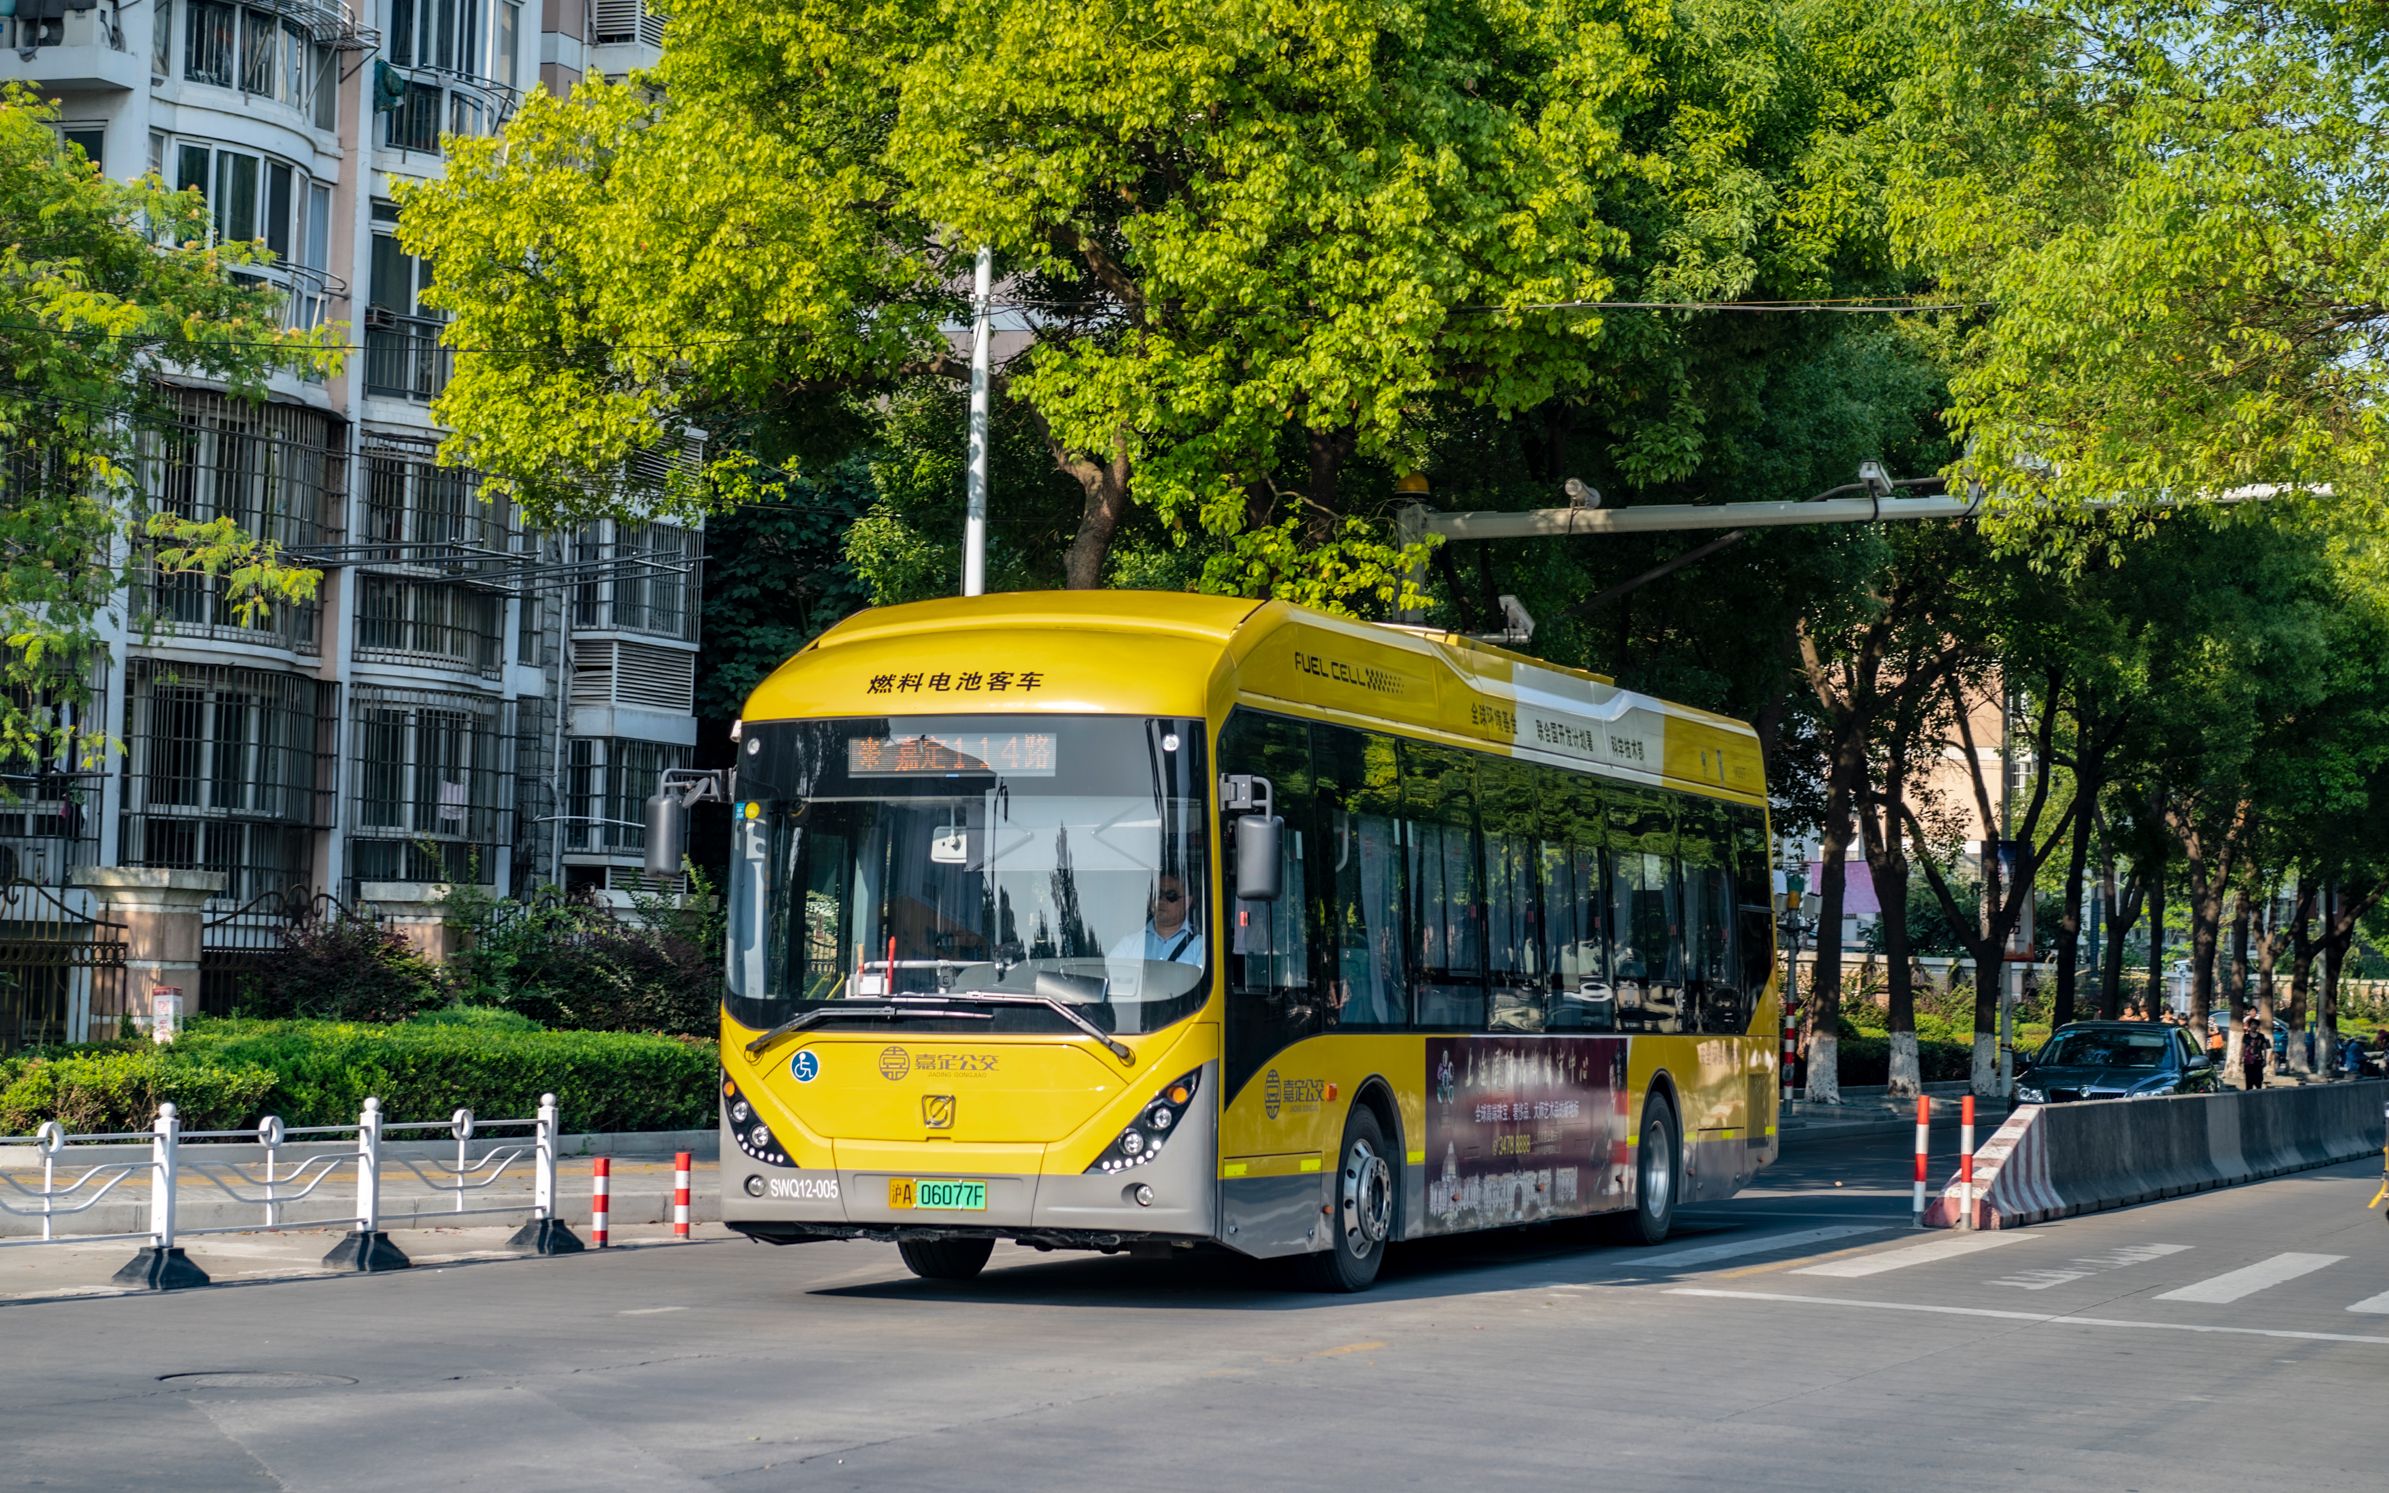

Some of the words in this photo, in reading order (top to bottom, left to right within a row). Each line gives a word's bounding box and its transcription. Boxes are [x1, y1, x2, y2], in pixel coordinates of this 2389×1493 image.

[1294, 651, 1328, 678] FUEL
[1331, 661, 1366, 686] CELL
[866, 671, 1044, 694] 燃料电池客车
[1471, 701, 1518, 735] 全球环境基金
[1535, 719, 1594, 752] 联合国开发计划署
[1610, 735, 1644, 761] 科学技术部
[895, 734, 1049, 771] 嘉定114路
[915, 1054, 1000, 1071] 嘉定公交
[1283, 1078, 1325, 1103] 嘉定公交
[1499, 1135, 1514, 1156] 3478
[1515, 1134, 1530, 1154] 8888
[770, 1178, 839, 1199] SWQ12-005
[891, 1183, 912, 1205] 沪A
[921, 1184, 985, 1206] 06077F
